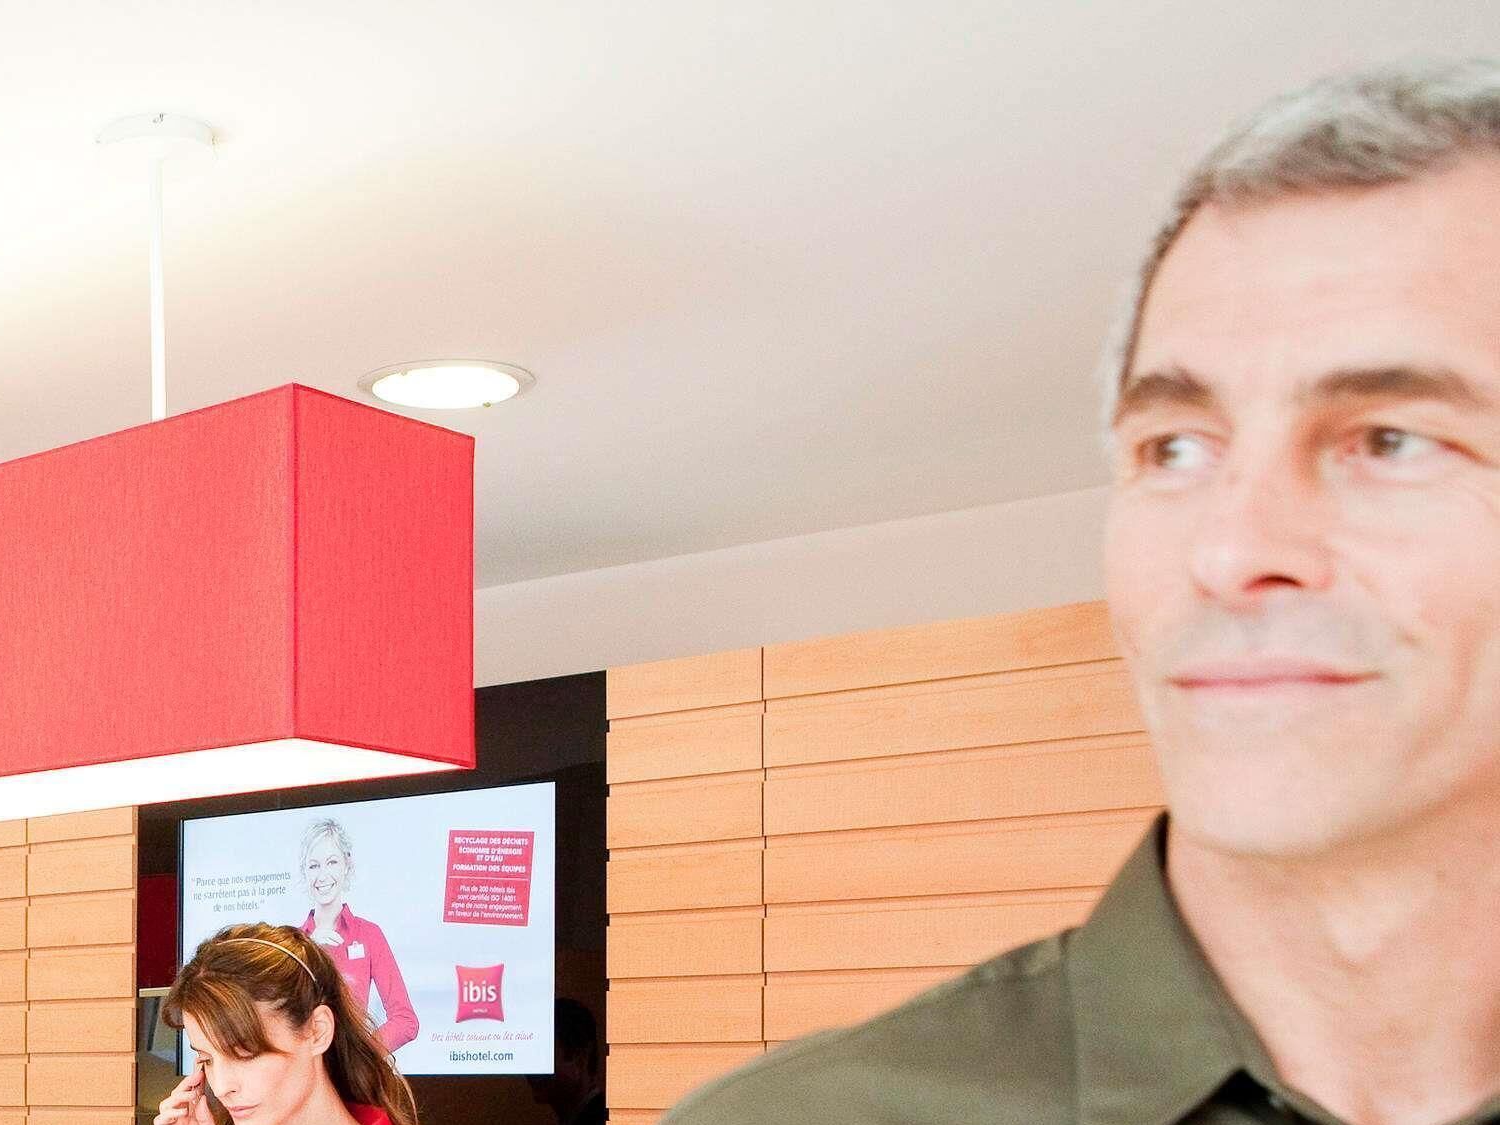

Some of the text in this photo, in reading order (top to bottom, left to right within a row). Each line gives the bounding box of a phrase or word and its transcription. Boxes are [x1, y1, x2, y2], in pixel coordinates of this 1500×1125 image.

[454, 837, 488, 845] RECYCLAGE
[231, 876, 243, 884] nos
[245, 872, 291, 884] engagements
[237, 889, 250, 899] pas
[258, 887, 265, 896] la
[266, 886, 286, 896] porte
[463, 980, 497, 1003] ibis
[449, 1051, 514, 1061] ibishotel.com
